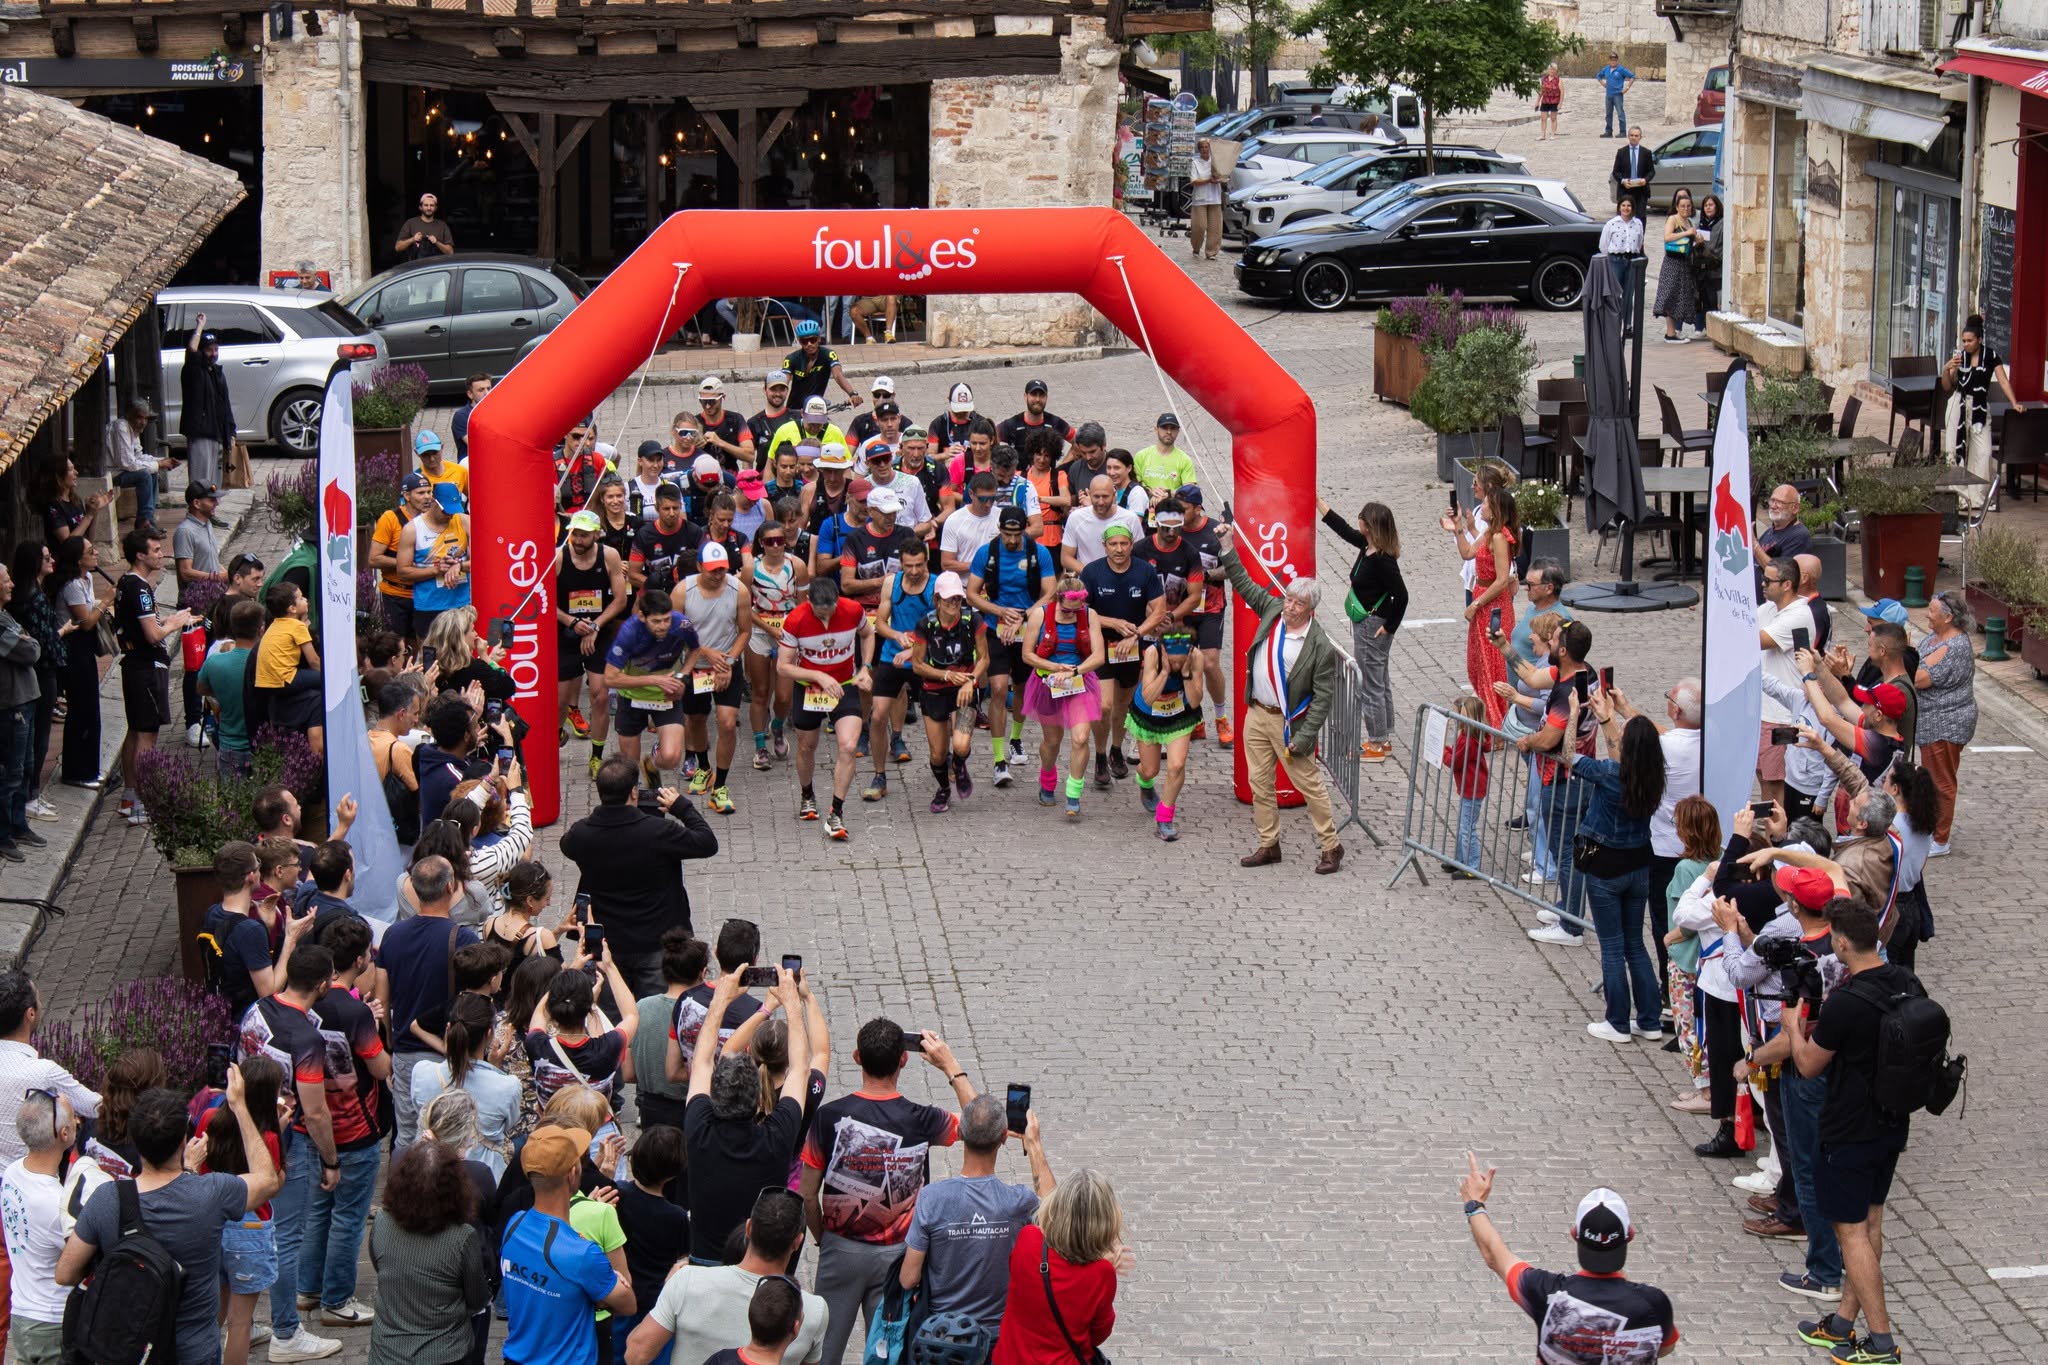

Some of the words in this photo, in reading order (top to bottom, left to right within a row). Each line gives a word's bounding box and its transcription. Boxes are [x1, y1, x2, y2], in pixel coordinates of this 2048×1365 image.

[171, 64, 214, 72] BOISSON
[171, 71, 215, 81] MOLINIÉ
[811, 224, 980, 270] foul&es
[948, 1228, 971, 1236] TRAILS
[531, 1271, 549, 1287] 47
